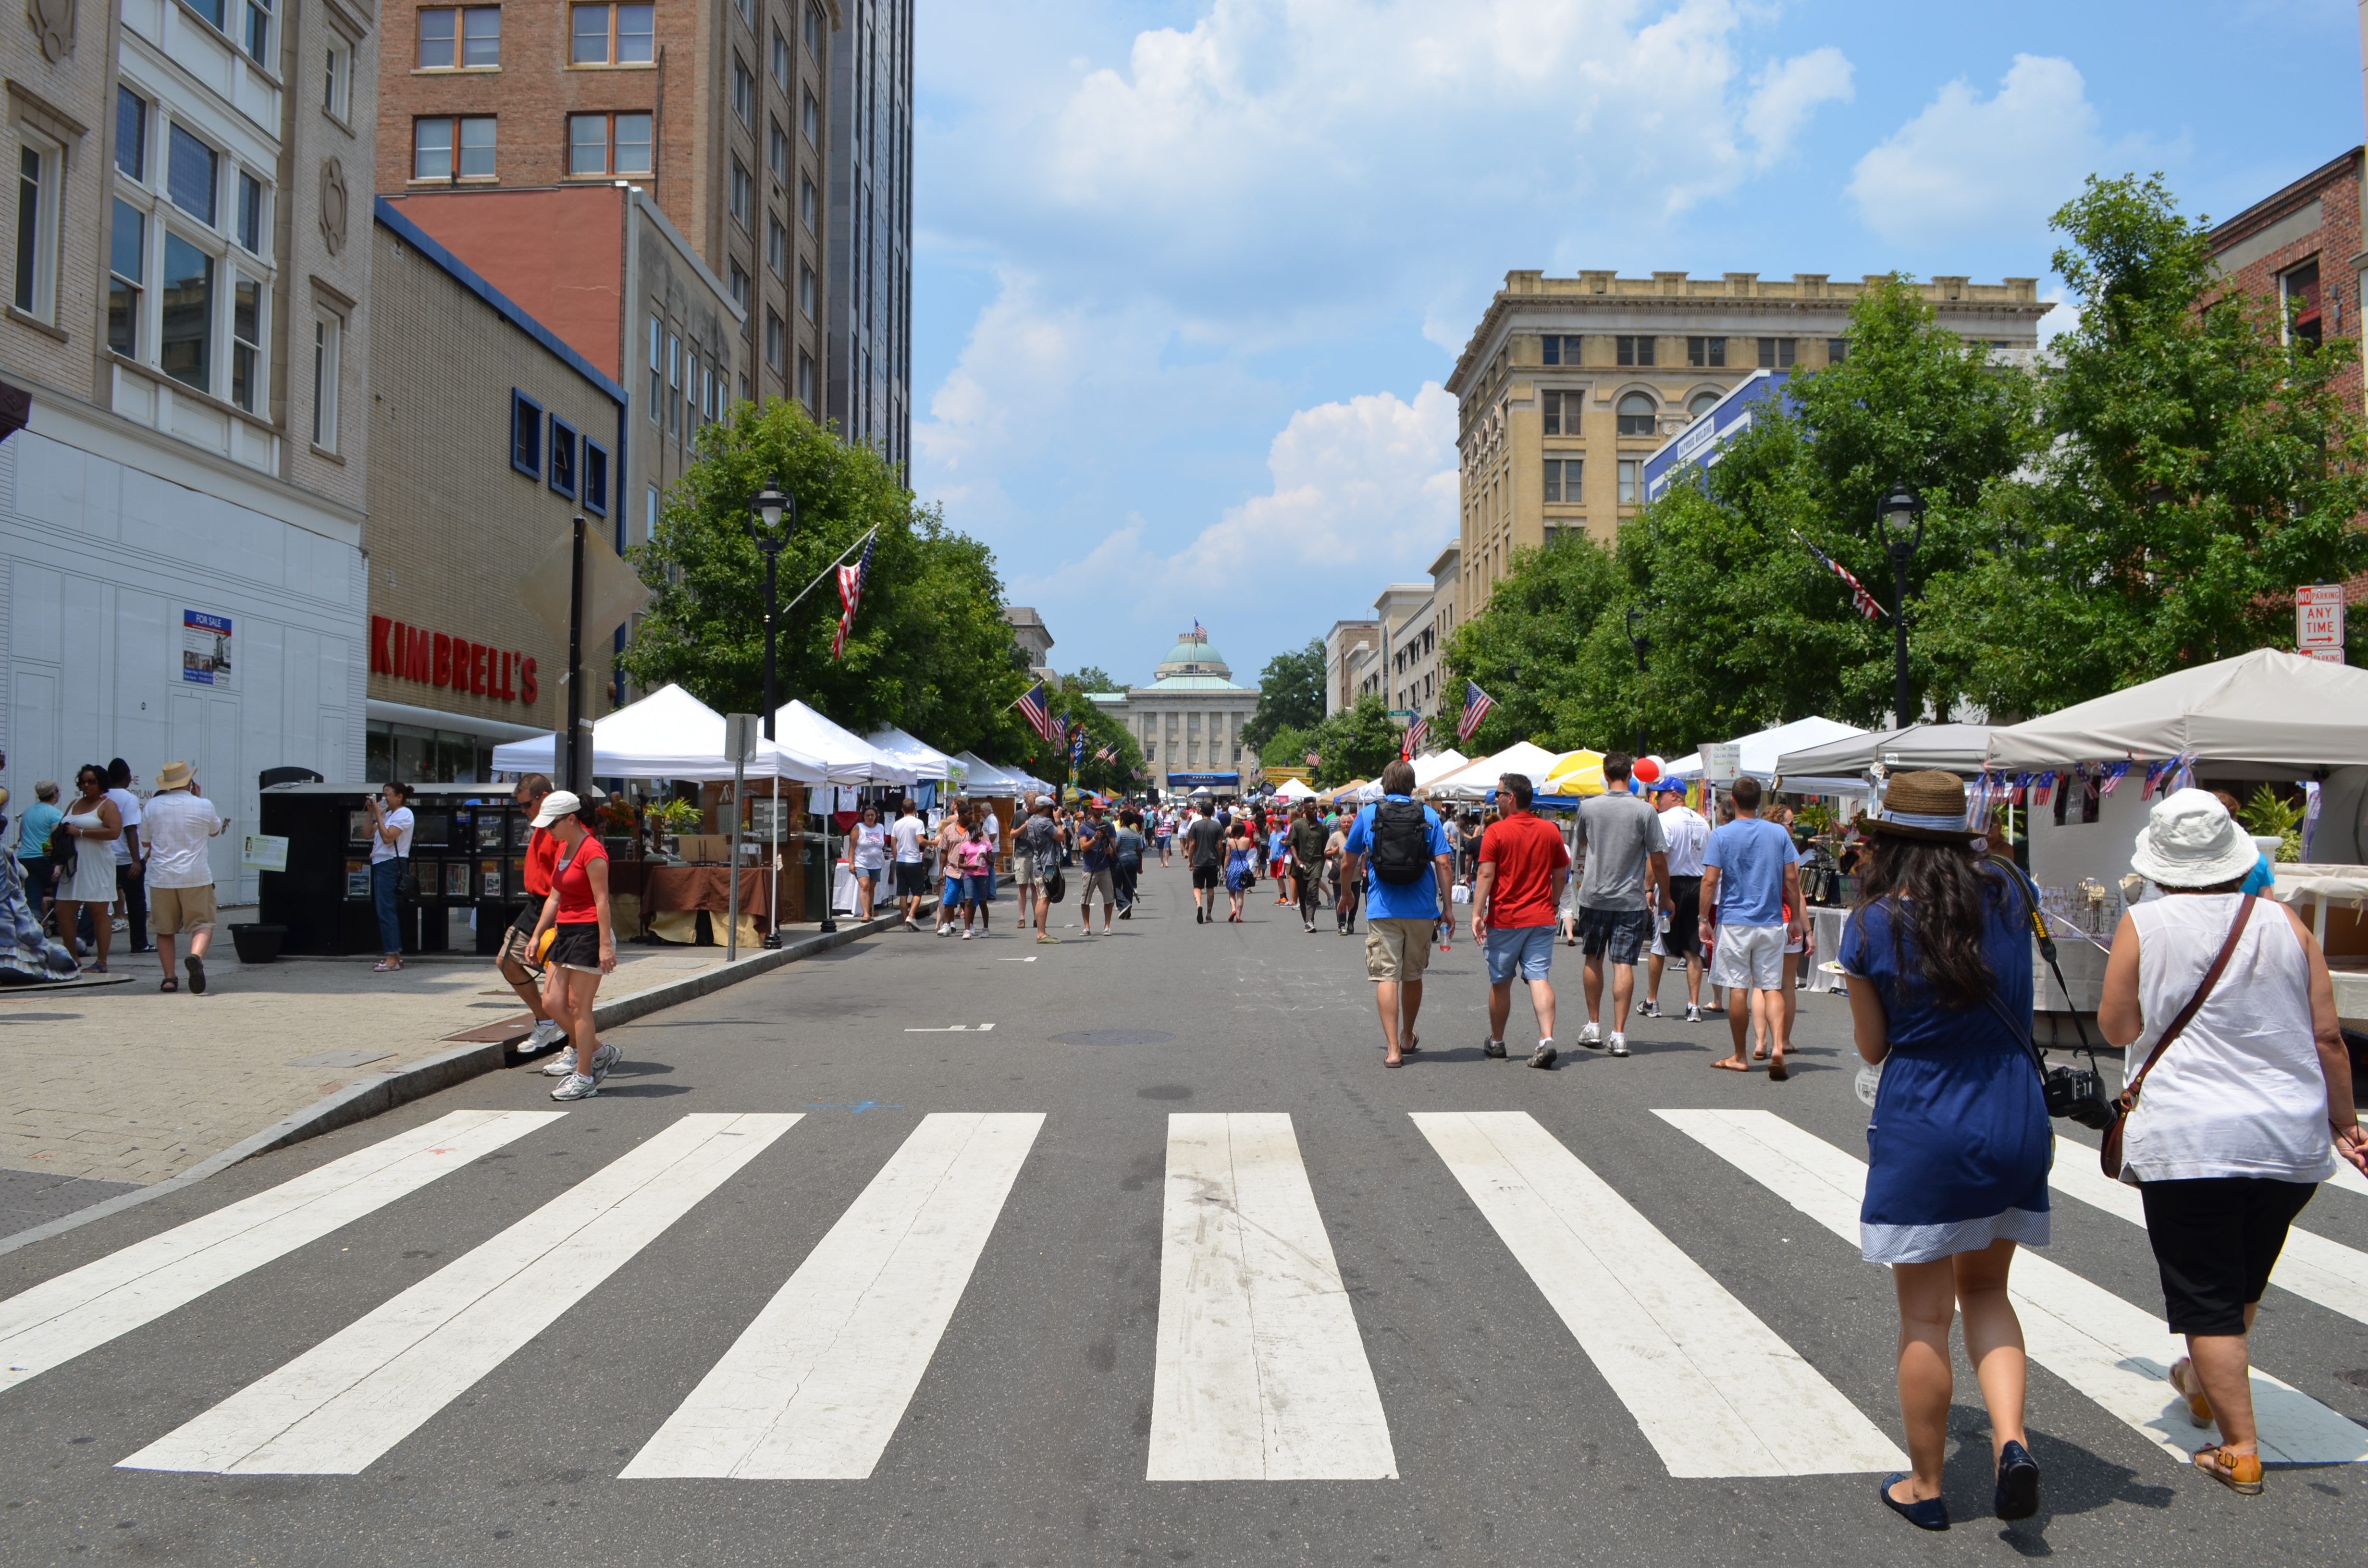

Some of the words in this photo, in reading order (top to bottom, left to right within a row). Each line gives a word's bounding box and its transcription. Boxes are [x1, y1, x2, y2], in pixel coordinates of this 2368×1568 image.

[1679, 436, 1694, 455] HAYWOOD
[1696, 423, 1712, 443] BUILDING
[2299, 591, 2310, 603] NO
[2312, 591, 2340, 601] PARKING
[2307, 607, 2332, 619] ANY
[196, 614, 208, 625] FOR
[209, 617, 222, 628] SALE
[2306, 621, 2334, 634] TIME
[371, 614, 538, 704] KIMBRELL'S
[127, 789, 152, 799] OYLAN
[2032, 912, 2047, 938] Nikon
